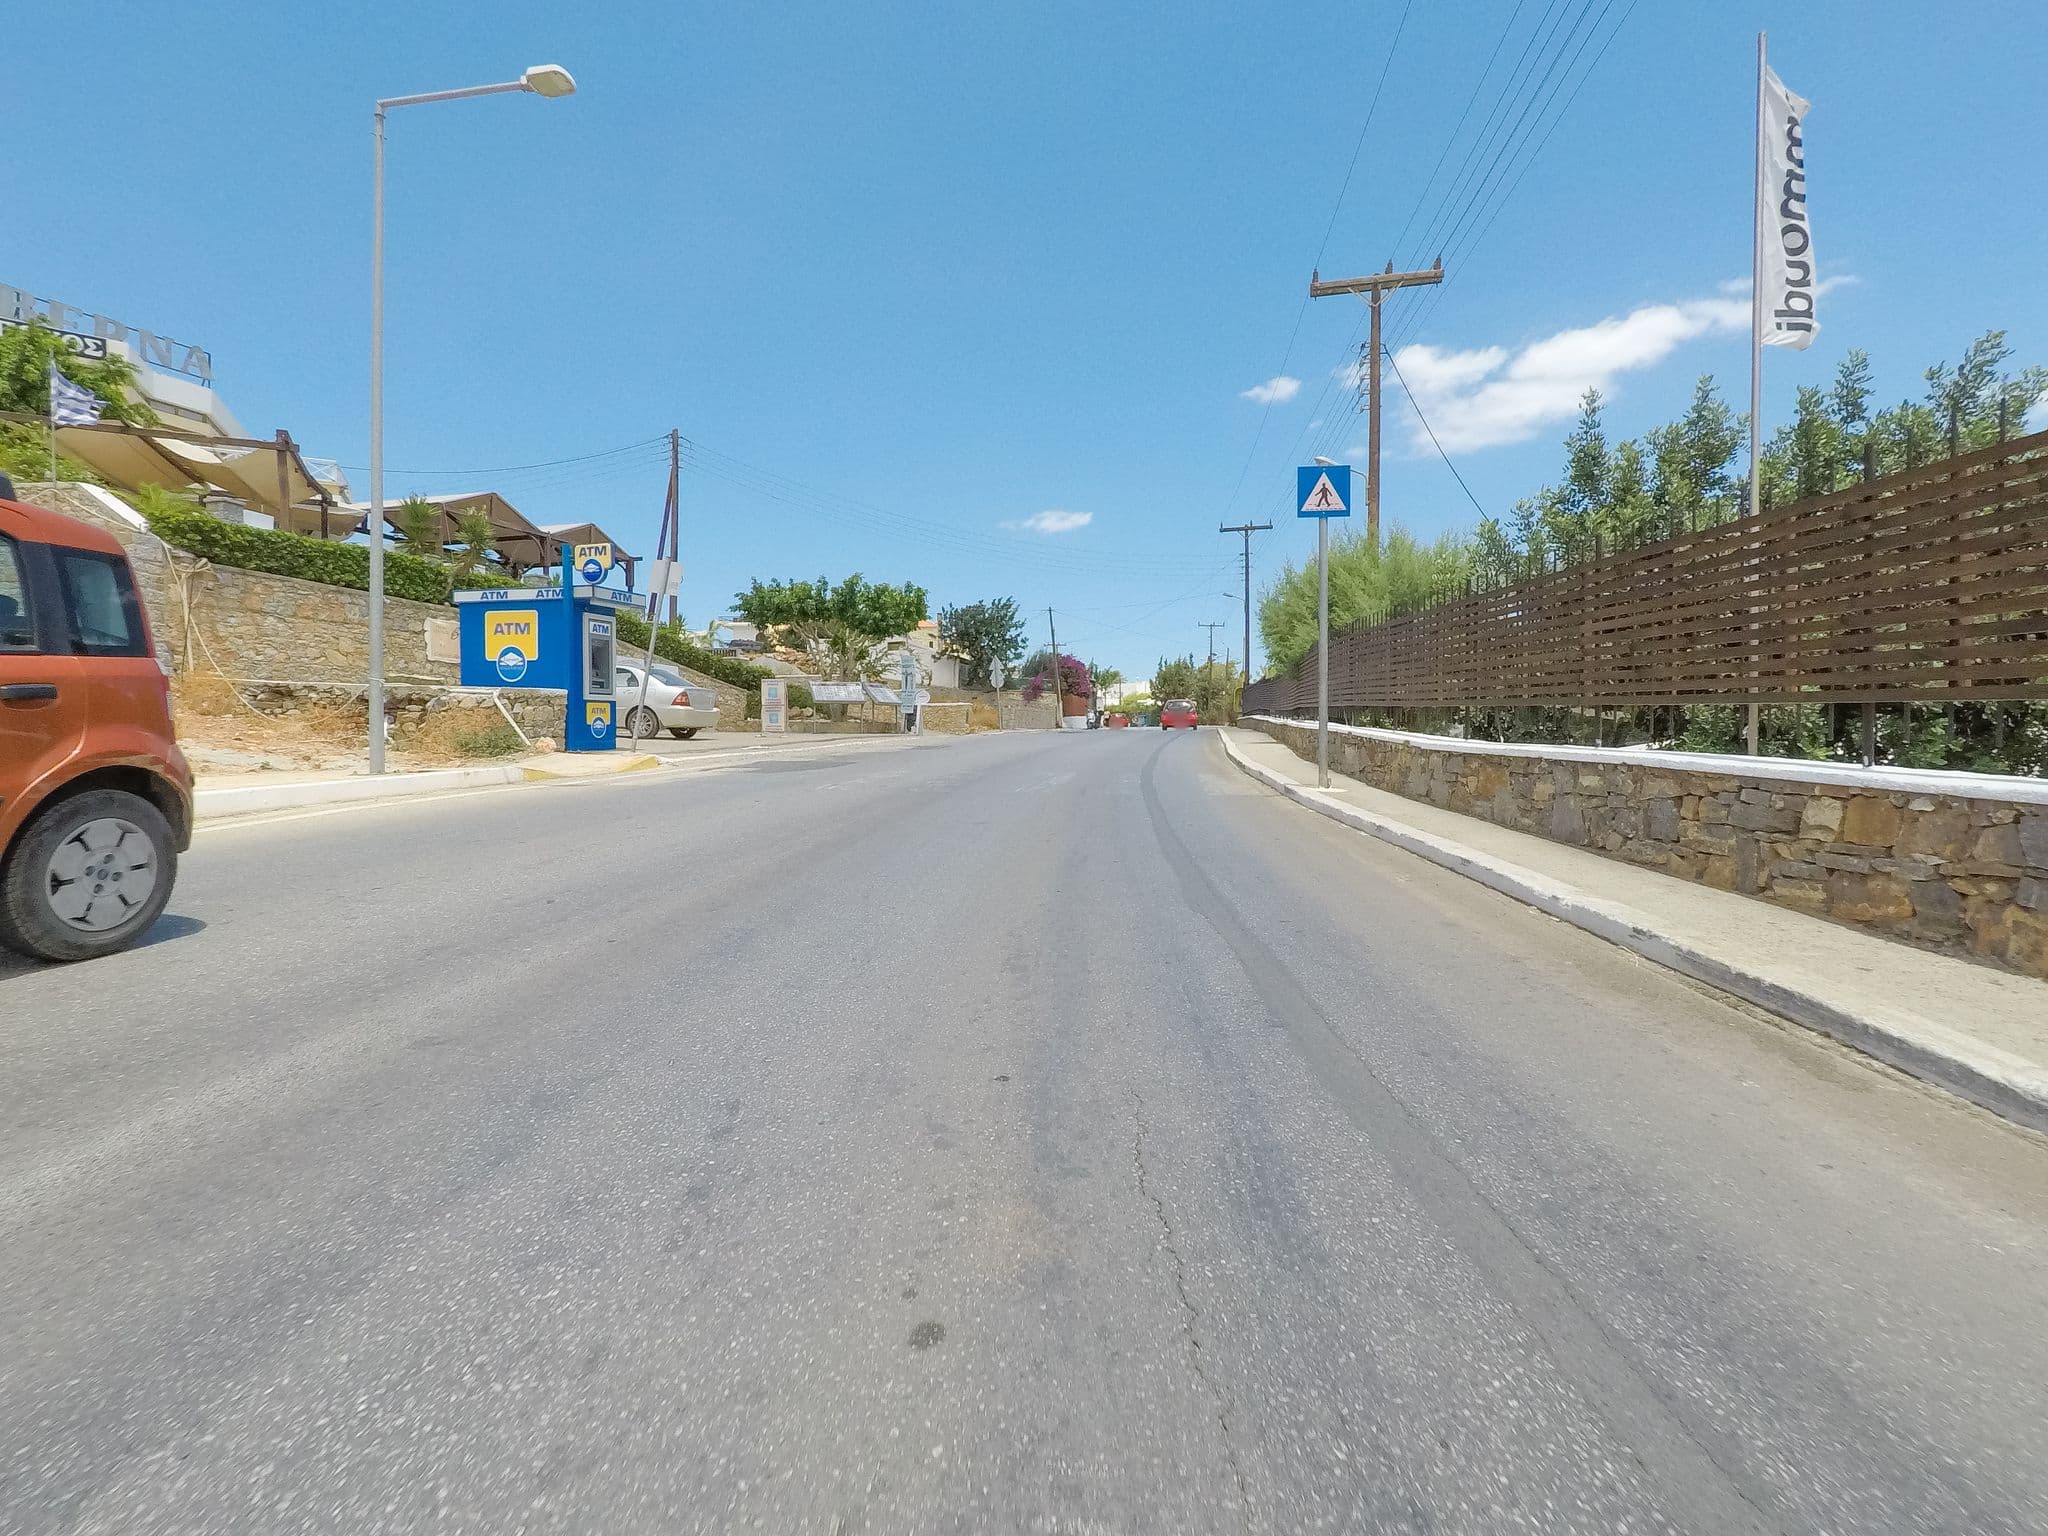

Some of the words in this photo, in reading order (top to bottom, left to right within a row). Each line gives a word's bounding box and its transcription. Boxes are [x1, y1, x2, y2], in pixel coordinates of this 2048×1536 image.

[579, 546, 607, 558] ATM
[480, 591, 509, 600] ATM
[535, 589, 563, 599] ATM
[611, 592, 633, 603] ATM
[493, 622, 531, 636] ATM
[592, 624, 609, 635] ATM
[591, 707, 606, 715] ATM
